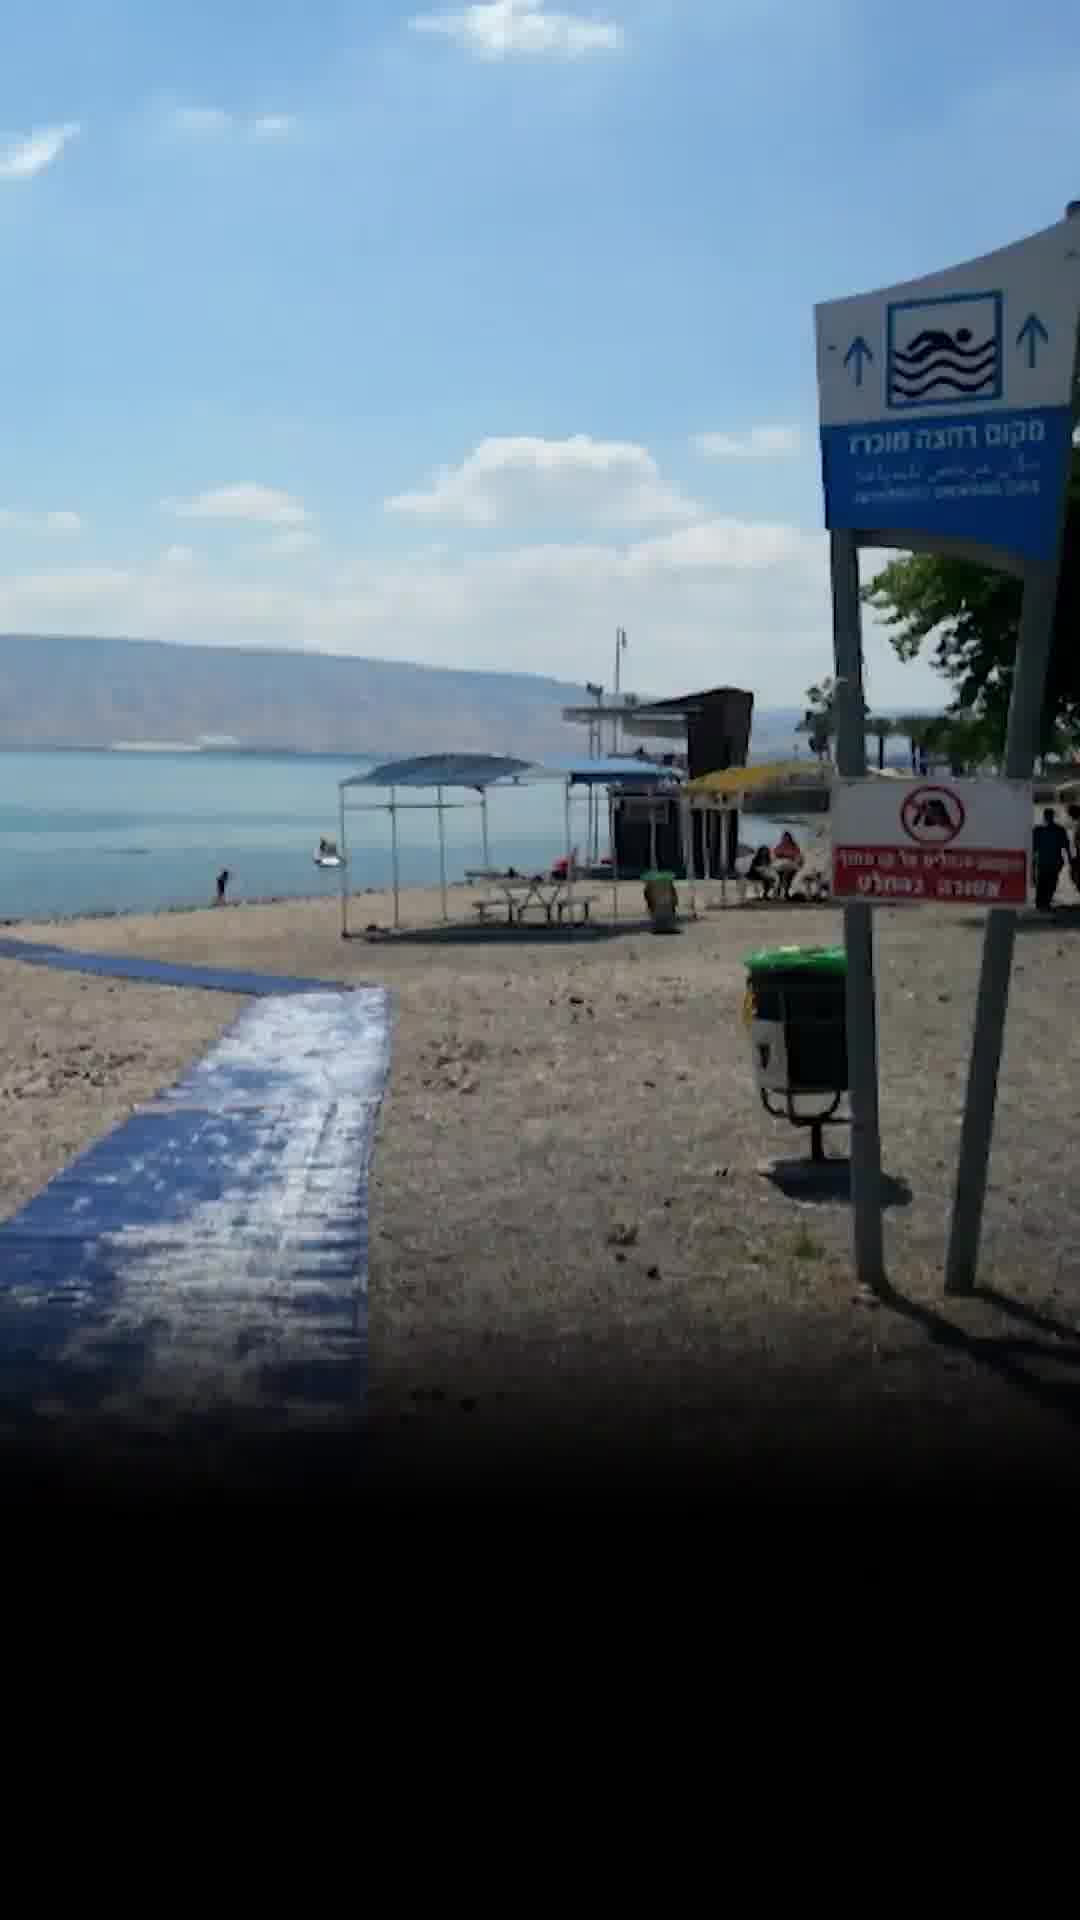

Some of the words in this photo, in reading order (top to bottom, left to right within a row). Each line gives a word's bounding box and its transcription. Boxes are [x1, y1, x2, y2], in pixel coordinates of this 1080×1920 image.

[848, 431, 911, 455] מוכרז
[915, 426, 977, 449] רחצה
[984, 419, 1045, 449] מקום
